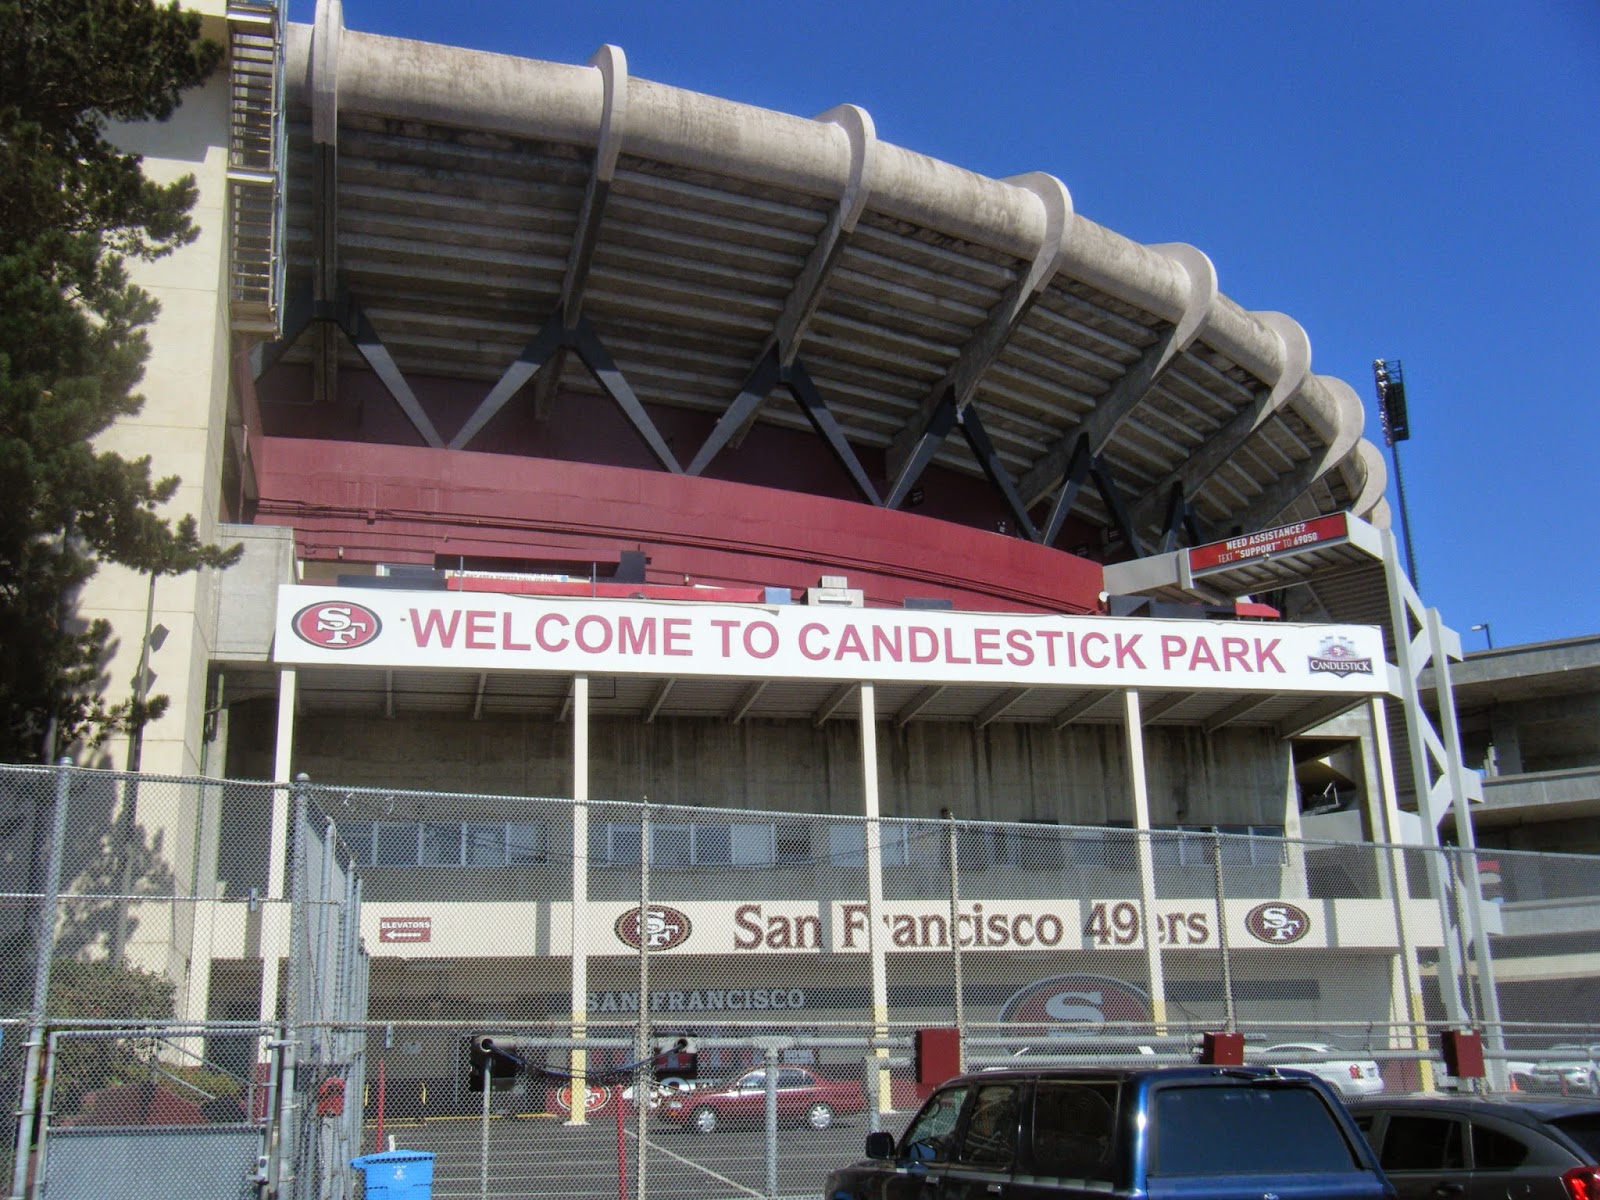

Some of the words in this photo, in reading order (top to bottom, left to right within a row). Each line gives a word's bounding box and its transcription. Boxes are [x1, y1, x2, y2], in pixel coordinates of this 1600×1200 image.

[1218, 552, 1233, 563] TEXT
[1283, 539, 1292, 548] TO
[1293, 532, 1318, 546] 69050
[1226, 537, 1247, 550] NEED
[1250, 523, 1306, 544] ASSISTANCE?
[409, 607, 694, 657] WELCOME
[710, 619, 780, 660] TO
[798, 621, 1148, 671] CANDLESTICK
[1161, 634, 1286, 674] PARK
[1310, 659, 1372, 672] CANDLESTICK
[381, 921, 430, 929] ELEVATORS
[734, 904, 825, 950] San
[841, 902, 1065, 948] Fancisco
[586, 991, 641, 1012] SAN
[648, 989, 805, 1011] FRANCISCO
